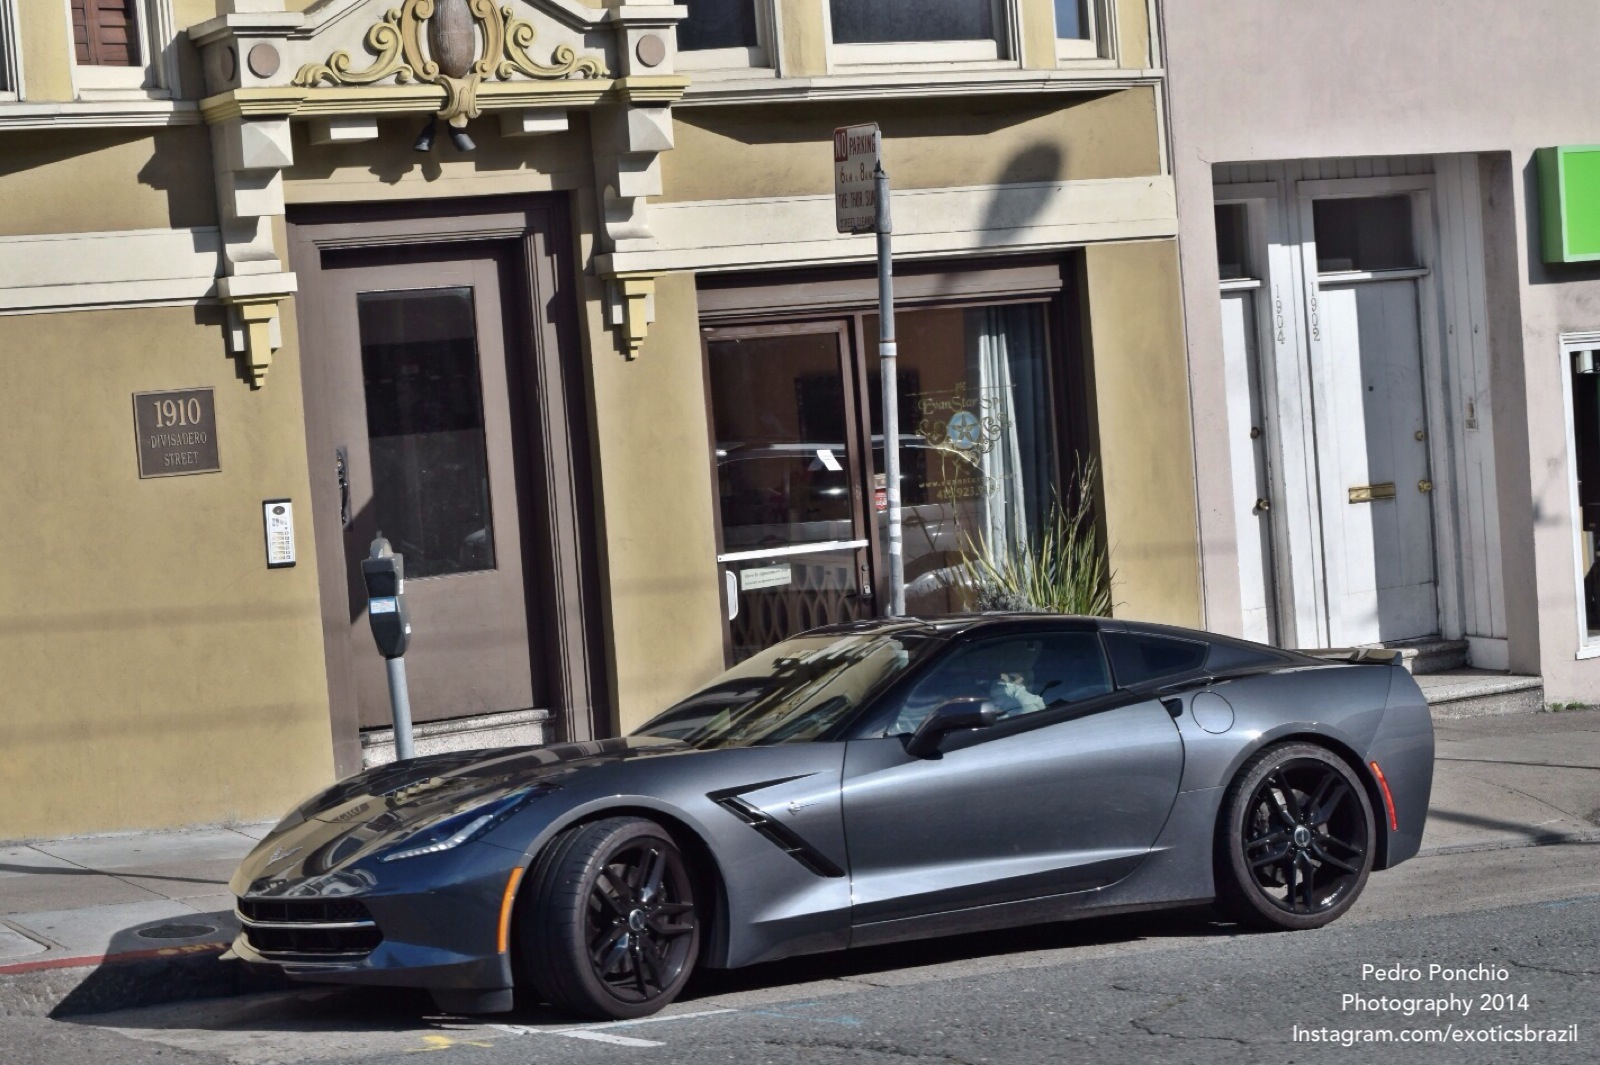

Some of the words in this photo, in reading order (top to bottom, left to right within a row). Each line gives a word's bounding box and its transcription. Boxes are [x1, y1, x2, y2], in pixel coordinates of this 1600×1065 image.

[835, 133, 847, 158] NO
[849, 133, 876, 156] PARKING
[1276, 284, 1286, 345] 1904
[1311, 281, 1321, 342] 1902
[153, 397, 201, 428] 1910
[150, 431, 207, 449] DIVISADERO
[163, 451, 199, 467] STREET
